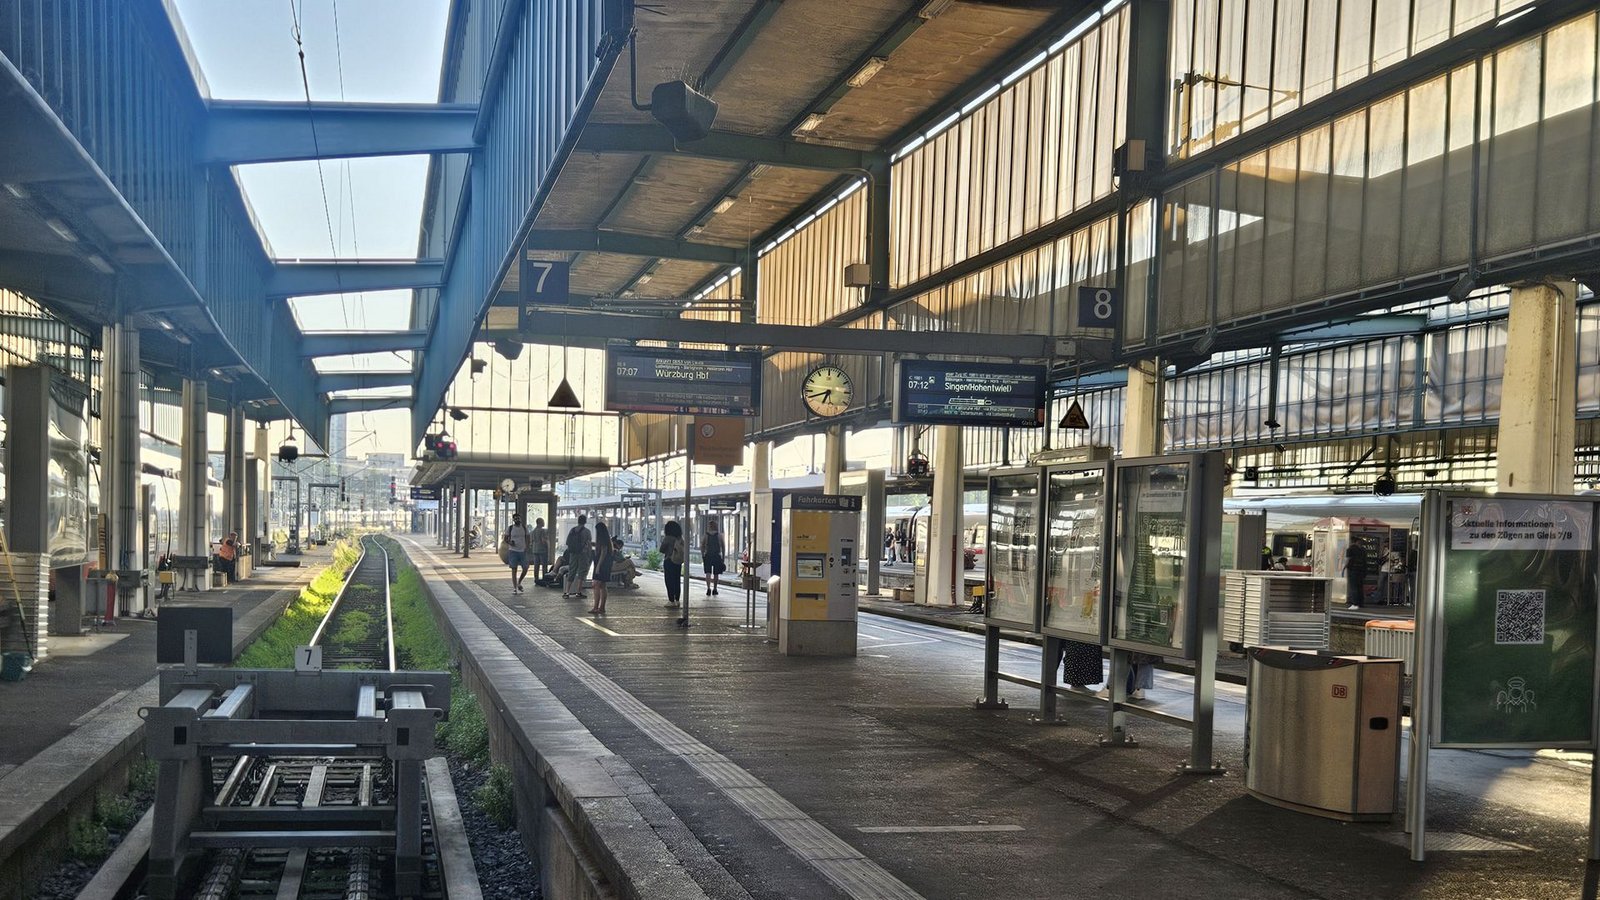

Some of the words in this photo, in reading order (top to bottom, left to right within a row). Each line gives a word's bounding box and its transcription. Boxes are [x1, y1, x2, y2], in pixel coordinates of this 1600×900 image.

[533, 262, 553, 293] 7
[1094, 289, 1112, 319] 8
[616, 367, 638, 376] 07:07
[655, 369, 693, 380] Würzburg
[696, 371, 709, 380] Hbf
[908, 380, 929, 390] 07:12
[798, 495, 836, 505] Fahrkarten
[1496, 520, 1554, 528] Informationen
[1497, 531, 1523, 540] Zügen
[1558, 532, 1572, 540] 7/8
[305, 649, 312, 665] 7
[1333, 687, 1346, 696] DB
